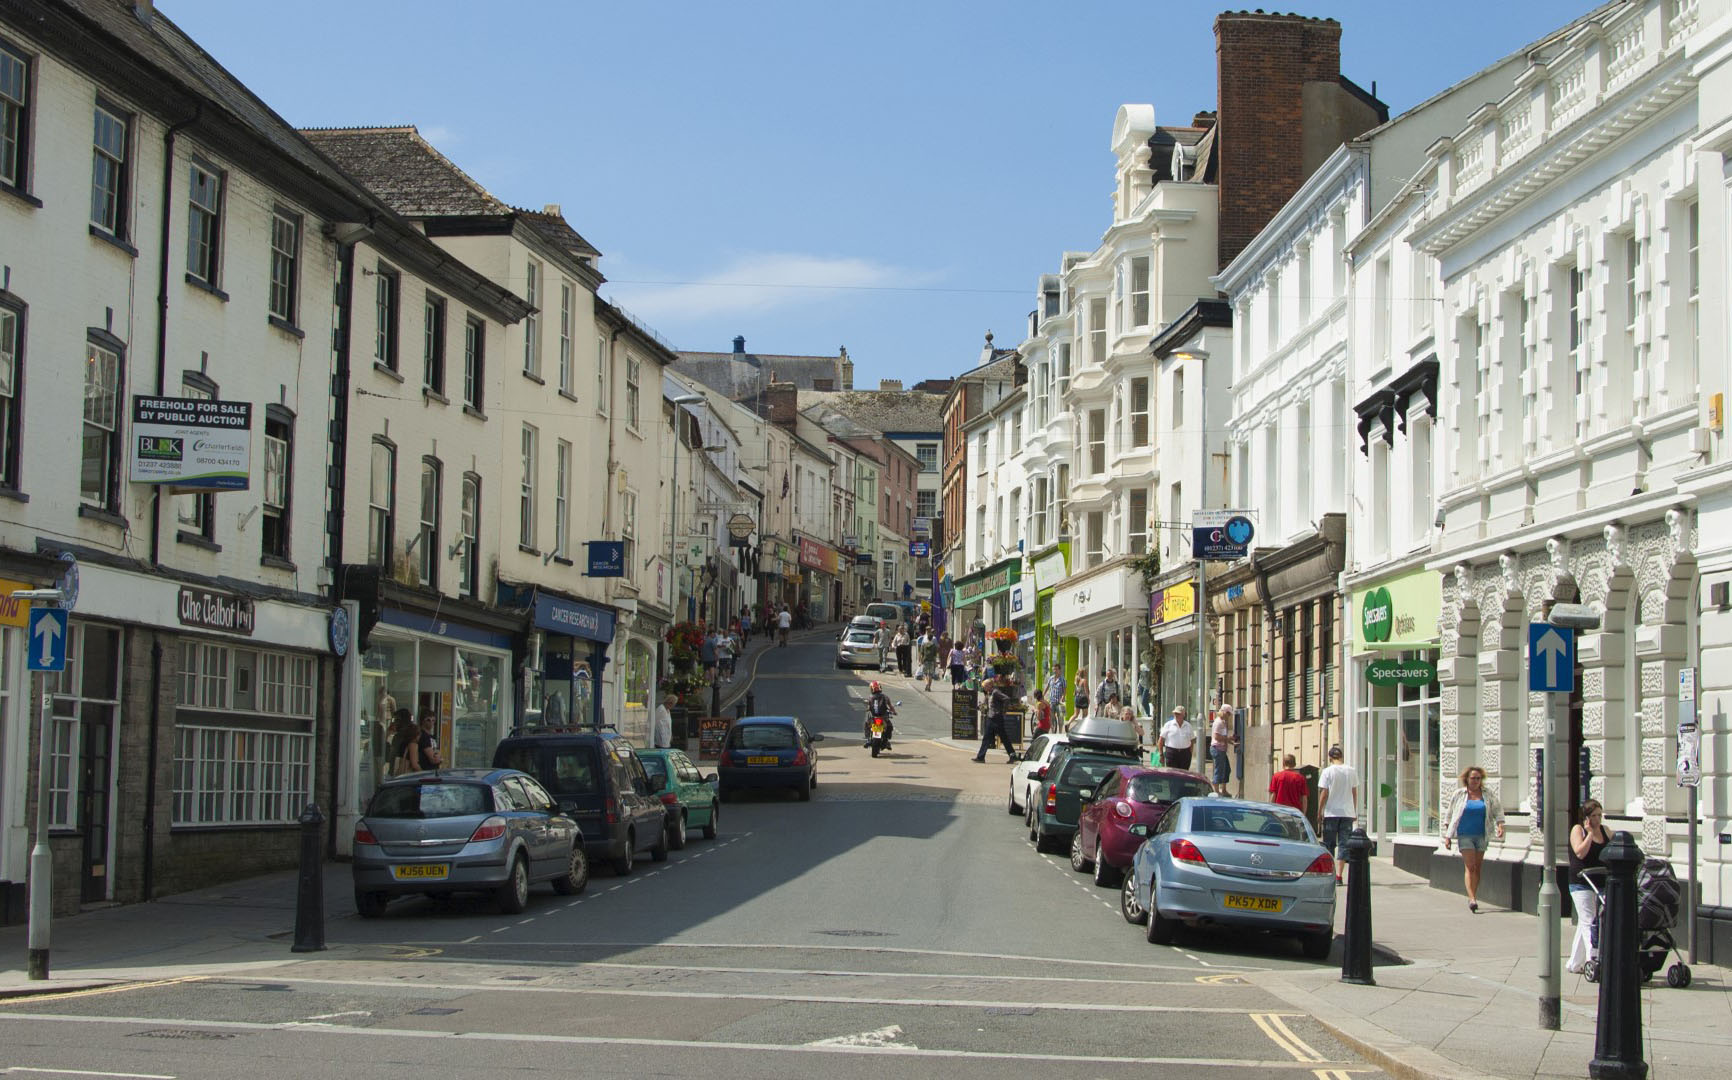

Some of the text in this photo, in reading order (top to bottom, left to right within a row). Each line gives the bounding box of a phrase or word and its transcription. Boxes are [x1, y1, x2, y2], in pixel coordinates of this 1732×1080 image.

[140, 400, 246, 414] FREEHOLD FOR SALE
[140, 411, 244, 425] BY PUBLIC AUCTION
[181, 590, 253, 631] The Talbot Inn
[551, 606, 569, 624] CANCER
[569, 610, 590, 629] RESEARCH
[1364, 605, 1387, 629] Specsavers
[1373, 667, 1429, 679] Specsavers
[1228, 895, 1256, 908] PK57
